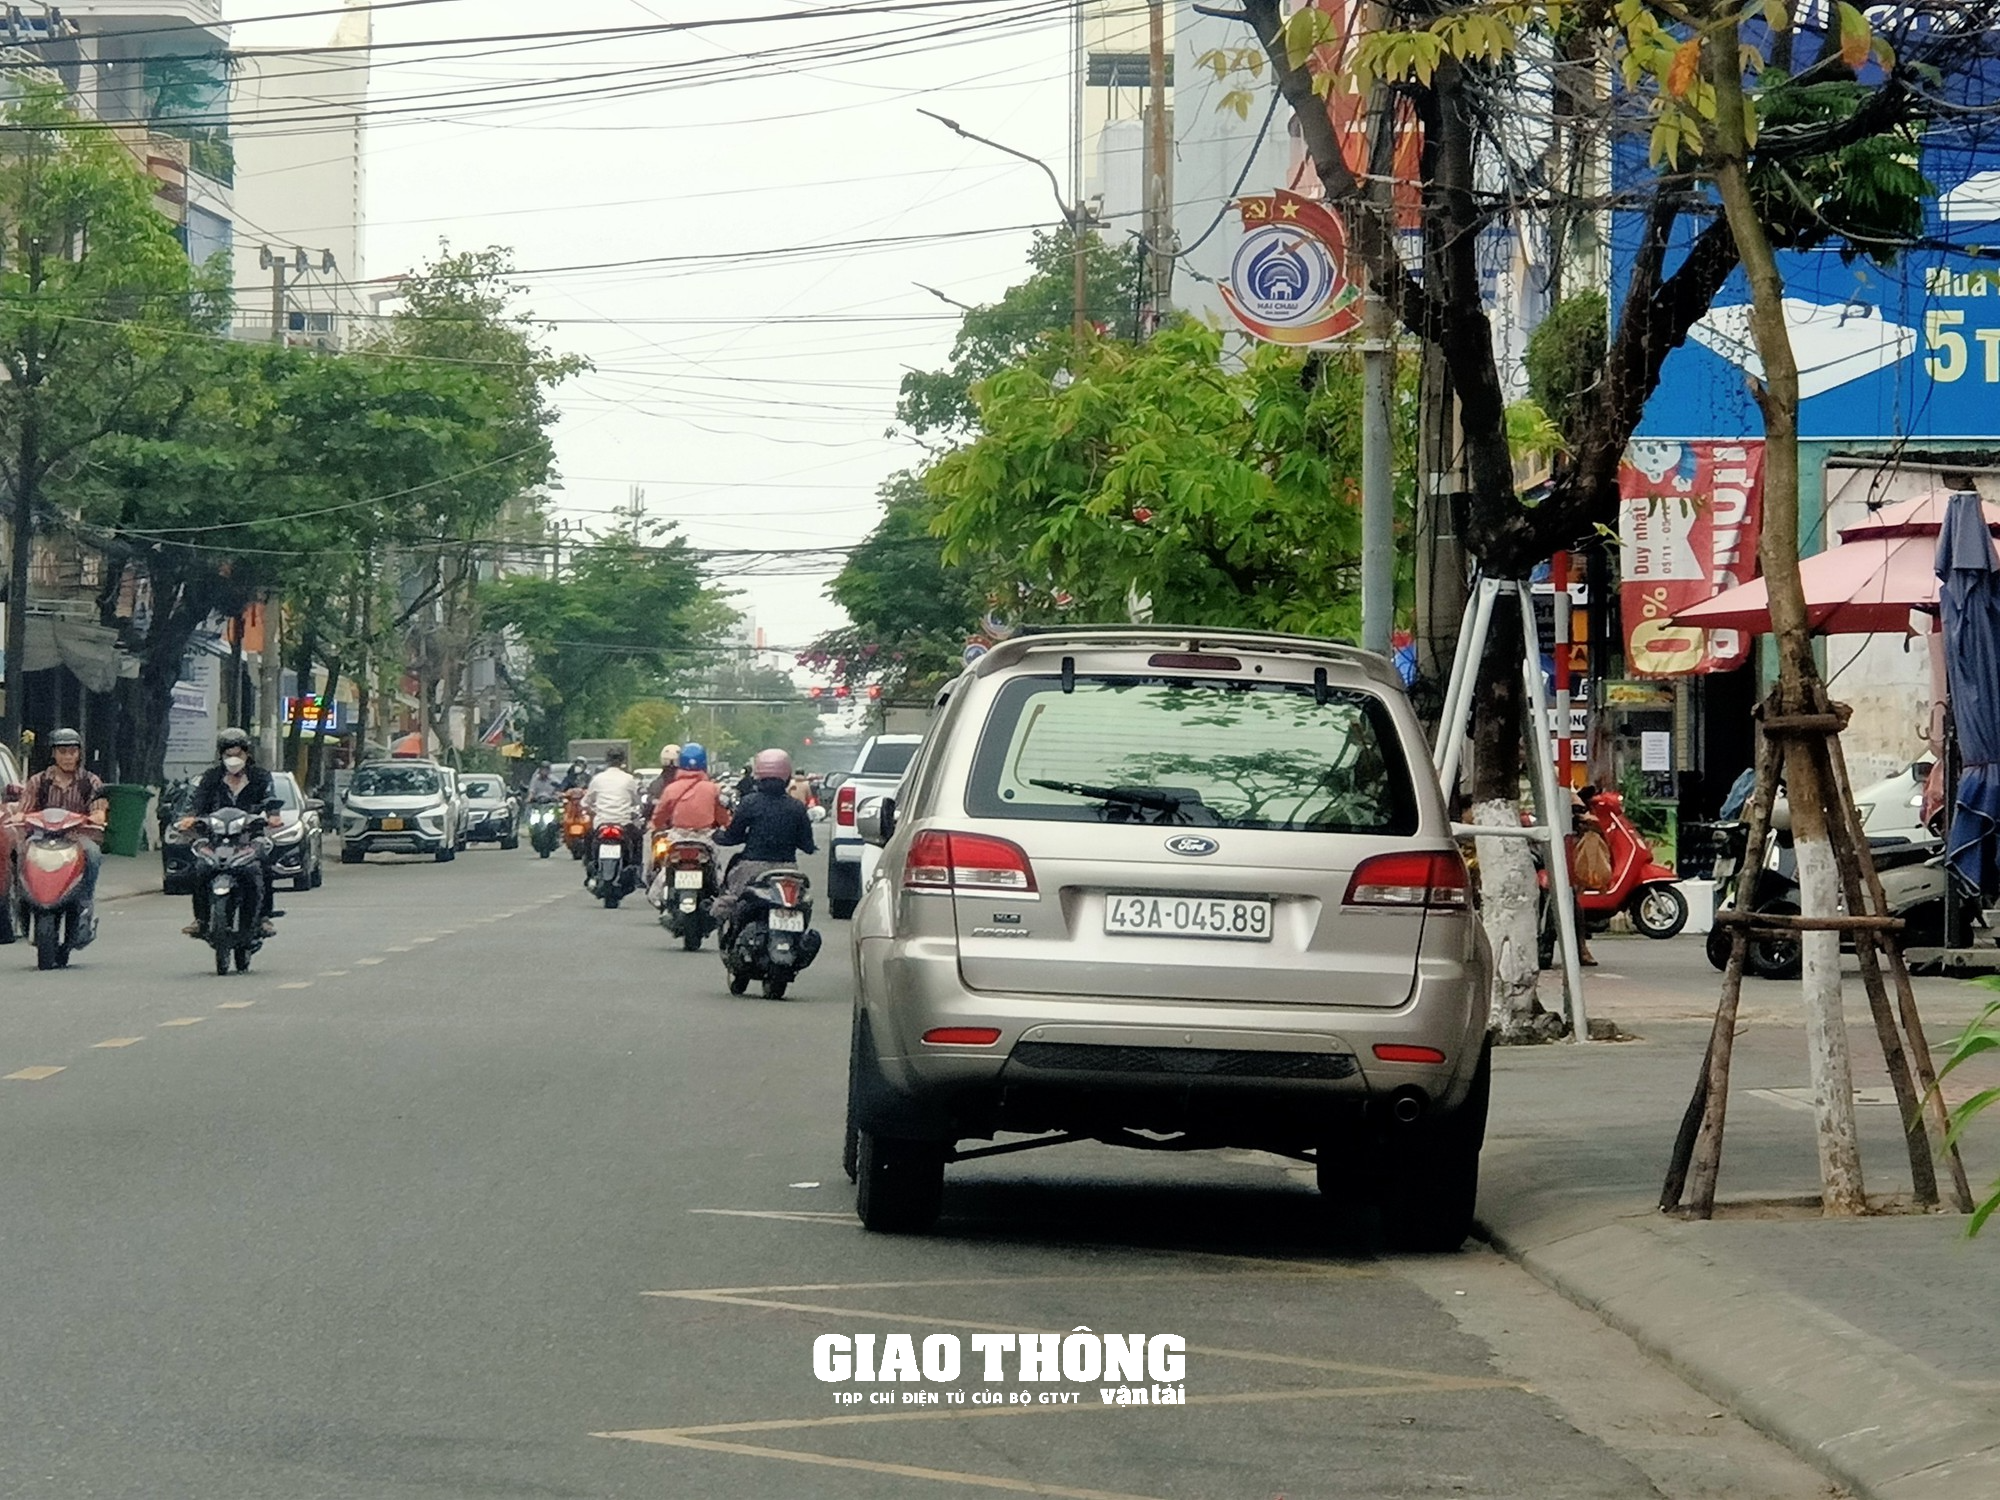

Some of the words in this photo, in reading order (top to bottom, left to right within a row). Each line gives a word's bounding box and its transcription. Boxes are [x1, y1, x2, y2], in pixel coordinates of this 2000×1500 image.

[1634, 547, 1651, 575] Duy
[1178, 838, 1207, 851] Ford
[1111, 899, 1265, 933] 43A-045.89
